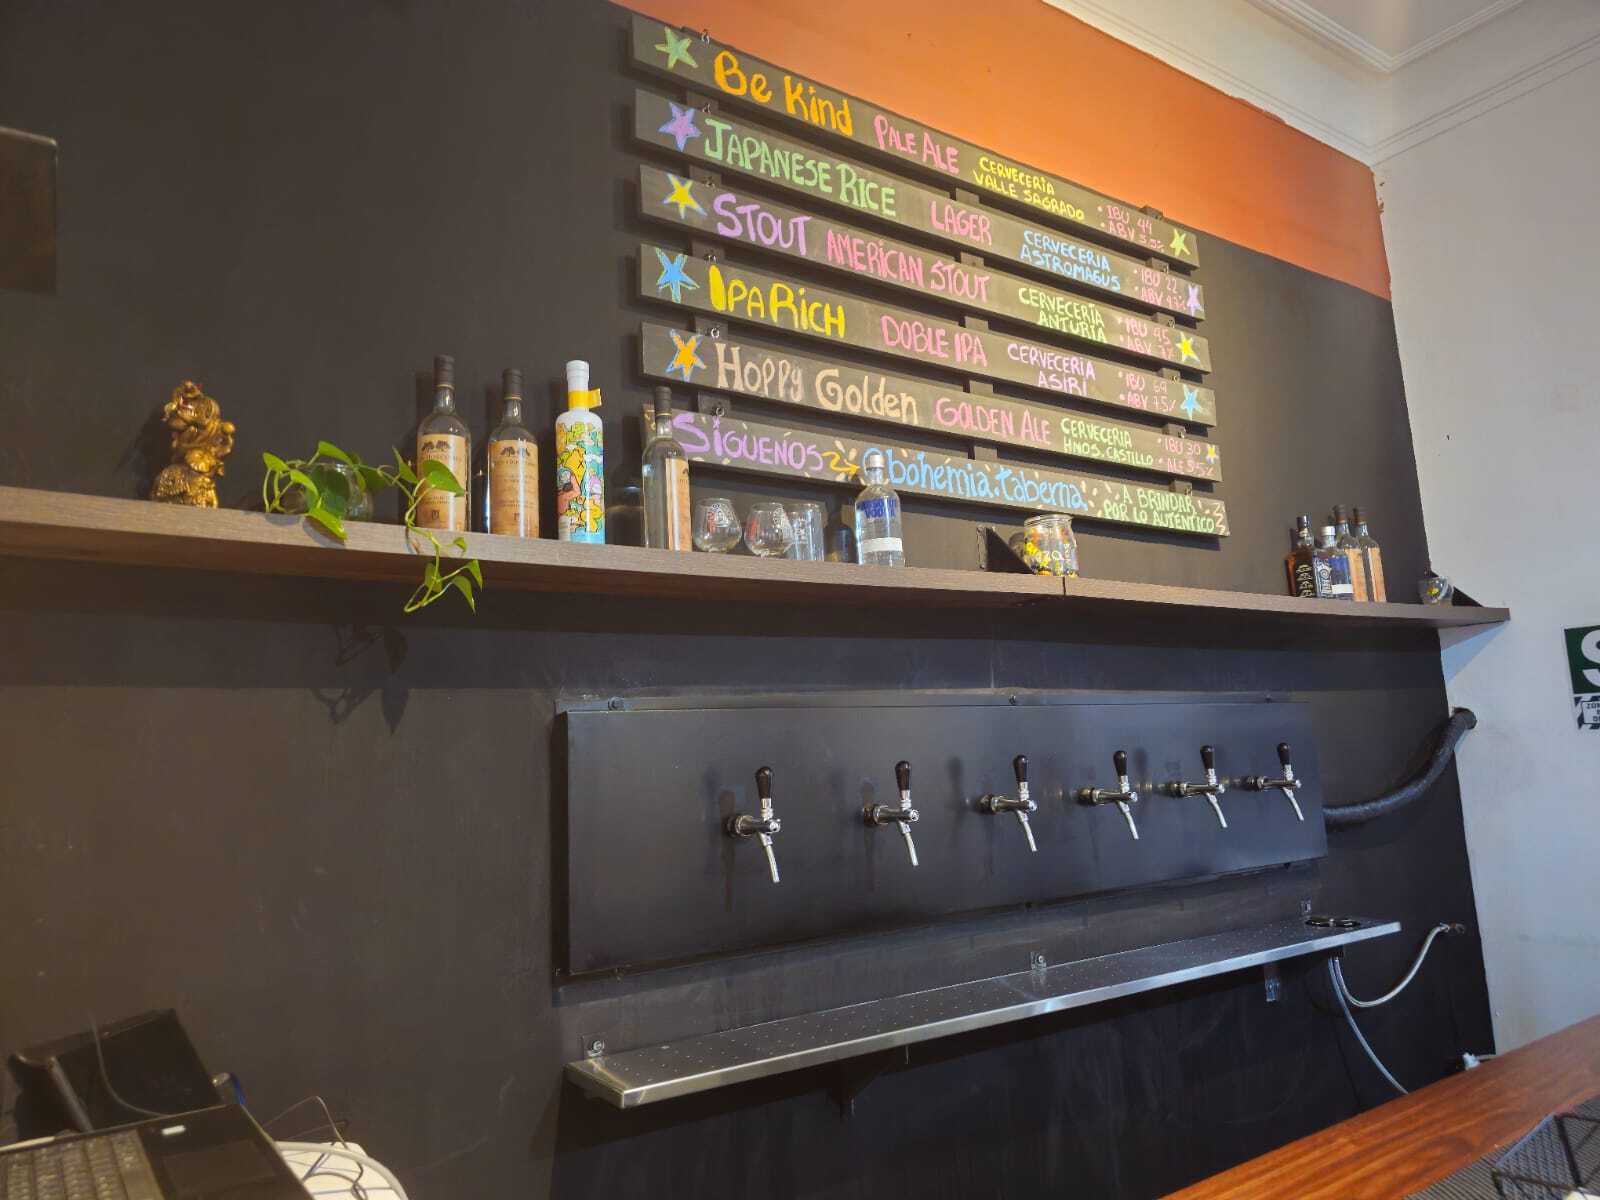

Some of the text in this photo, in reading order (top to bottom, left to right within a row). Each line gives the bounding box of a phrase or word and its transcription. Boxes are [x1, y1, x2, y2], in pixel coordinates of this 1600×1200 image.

[713, 50, 853, 137] Be Kind
[704, 118, 896, 217] JAPANESE RICE
[873, 114, 960, 175] PALE ALE
[973, 169, 1085, 220] VALLE SAGRADO
[713, 192, 813, 257] STOUT
[929, 200, 992, 246] LAGER
[930, 259, 990, 303] STOUT
[1020, 244, 1121, 293] ASTROMAGUS
[880, 315, 988, 367] DOBLE IPA
[714, 342, 918, 425] Hoppy Golden
[935, 397, 1051, 445] GOLDEN ALE
[1106, 446, 1154, 466] CASTILLO
[1103, 499, 1129, 521] POR
[1132, 505, 1148, 524] LO
[1122, 484, 1133, 505] A
